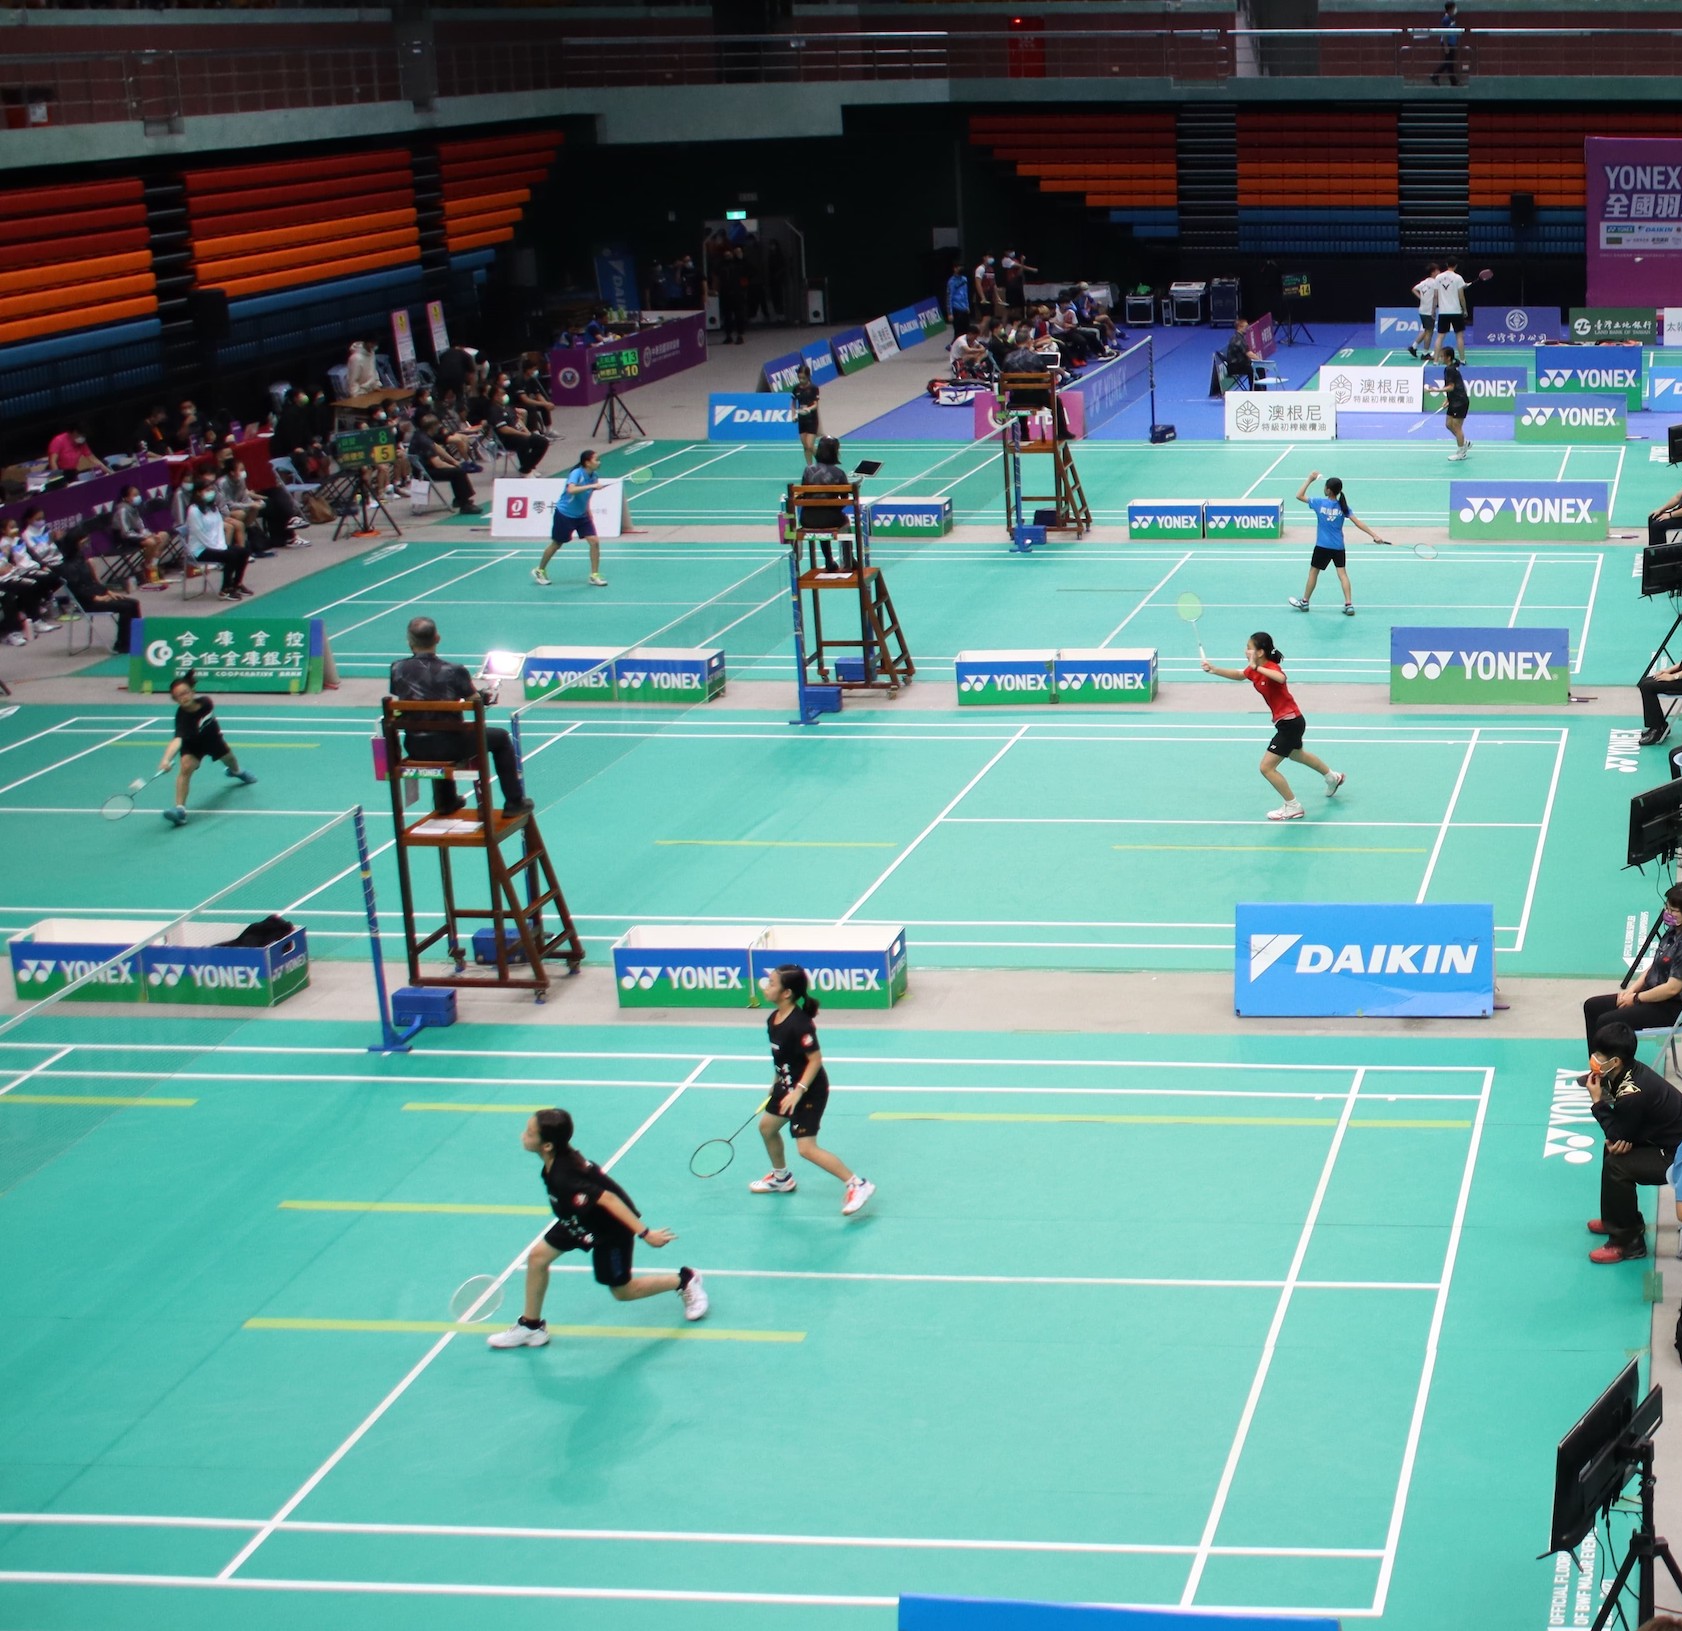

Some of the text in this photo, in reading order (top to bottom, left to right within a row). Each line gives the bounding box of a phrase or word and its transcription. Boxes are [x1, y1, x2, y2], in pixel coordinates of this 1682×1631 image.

[1604, 166, 1682, 190] YONEX
[624, 351, 637, 363] 13
[625, 364, 638, 377] 10
[1577, 369, 1637, 388] YONEX
[1360, 379, 1409, 394] 澳根尼
[1466, 380, 1518, 397] YONEX
[734, 410, 798, 423] DAIKI
[1268, 405, 1322, 421] 澳根尼
[1558, 407, 1617, 426] YONEX
[379, 431, 387, 444] 8
[381, 448, 389, 460] 5
[1511, 498, 1593, 524] YONEX
[898, 514, 939, 528] YONEX
[1156, 514, 1198, 529] YONEX
[1233, 514, 1275, 529] YONEX
[1461, 652, 1553, 680] YONEX
[556, 671, 609, 689] YONEX
[650, 672, 703, 689] YONEX
[994, 674, 1047, 692] YONEX
[1094, 673, 1145, 691] YONEX
[1607, 729, 1642, 755] YONEX
[418, 769, 443, 778] YONEX
[1296, 945, 1478, 973] DAIKIN
[61, 959, 135, 985] YONEX
[188, 964, 262, 989] YONEX
[667, 966, 742, 990] YONEX
[806, 968, 881, 991] YONEX
[1578, 1559, 1595, 1591] MAJOR
[1551, 1550, 1572, 1625] OFFICIAL FLOORI
[1576, 1590, 1592, 1613] BWF
[1574, 1612, 1590, 1625] OF
